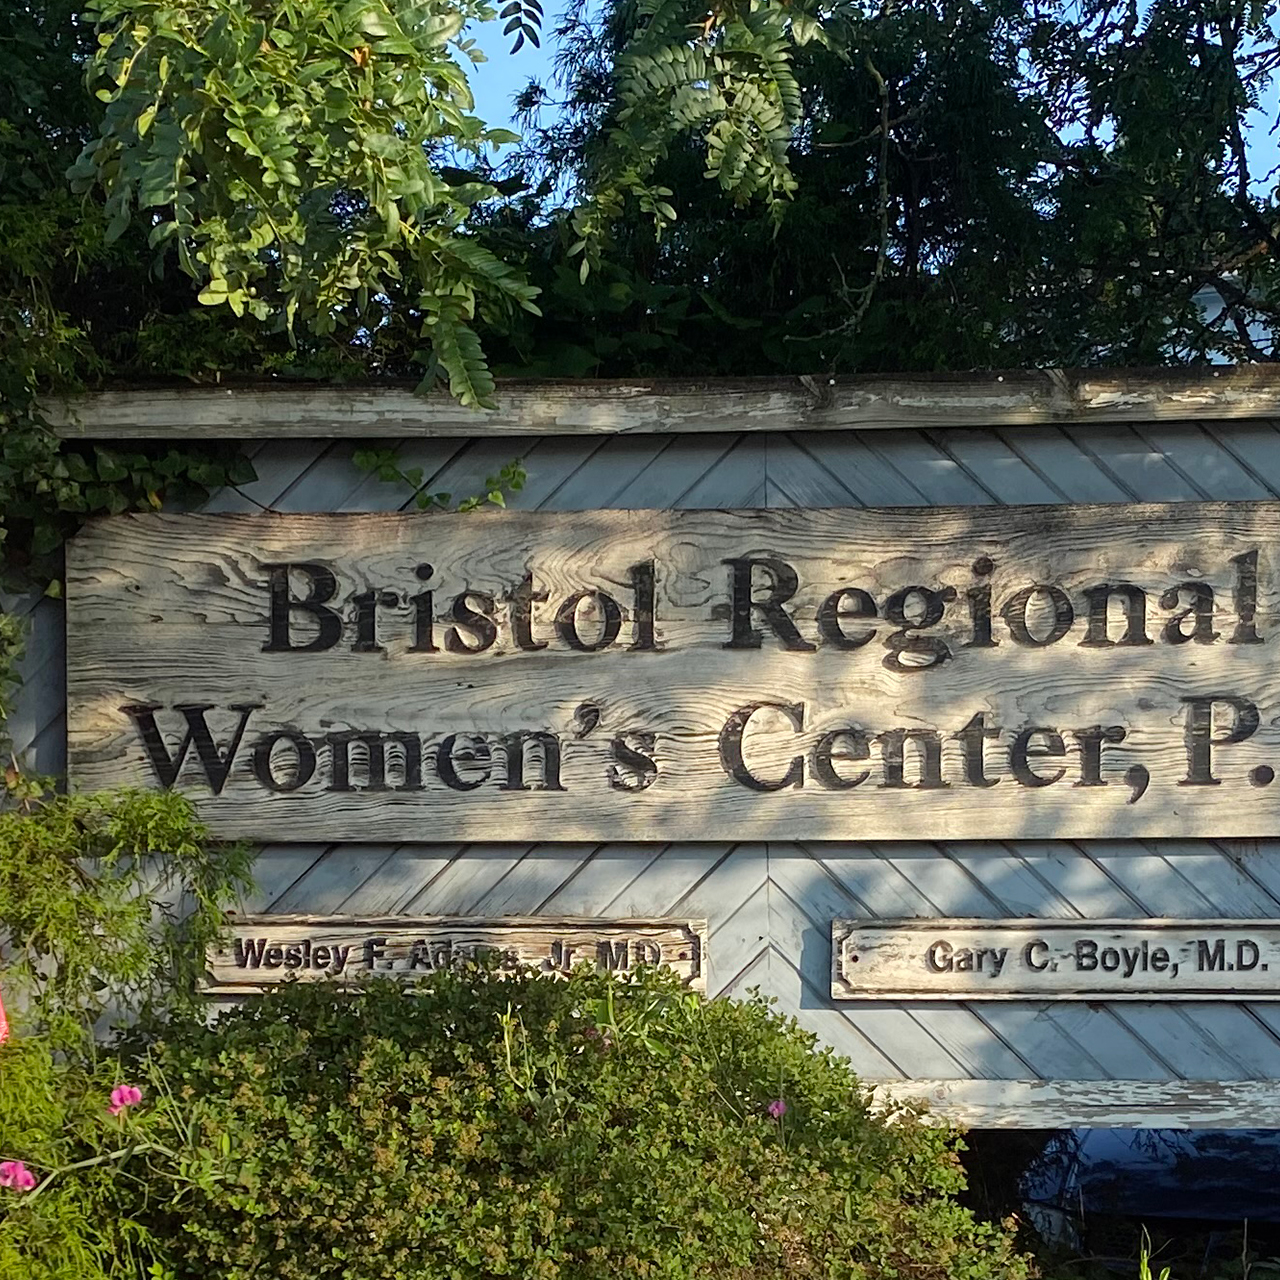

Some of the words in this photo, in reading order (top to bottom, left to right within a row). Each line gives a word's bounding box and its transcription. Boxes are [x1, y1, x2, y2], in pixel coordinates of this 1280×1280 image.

[259, 557, 666, 655] Bristol
[720, 550, 1265, 672] Regional
[122, 701, 659, 797] Women's
[719, 700, 1150, 804] Center,
[234, 938, 351, 976] Wesley
[926, 939, 1009, 978] Gary
[1024, 938, 1058, 972] C.
[1075, 939, 1180, 979] Boyle,
[1197, 939, 1268, 972] M.D.
